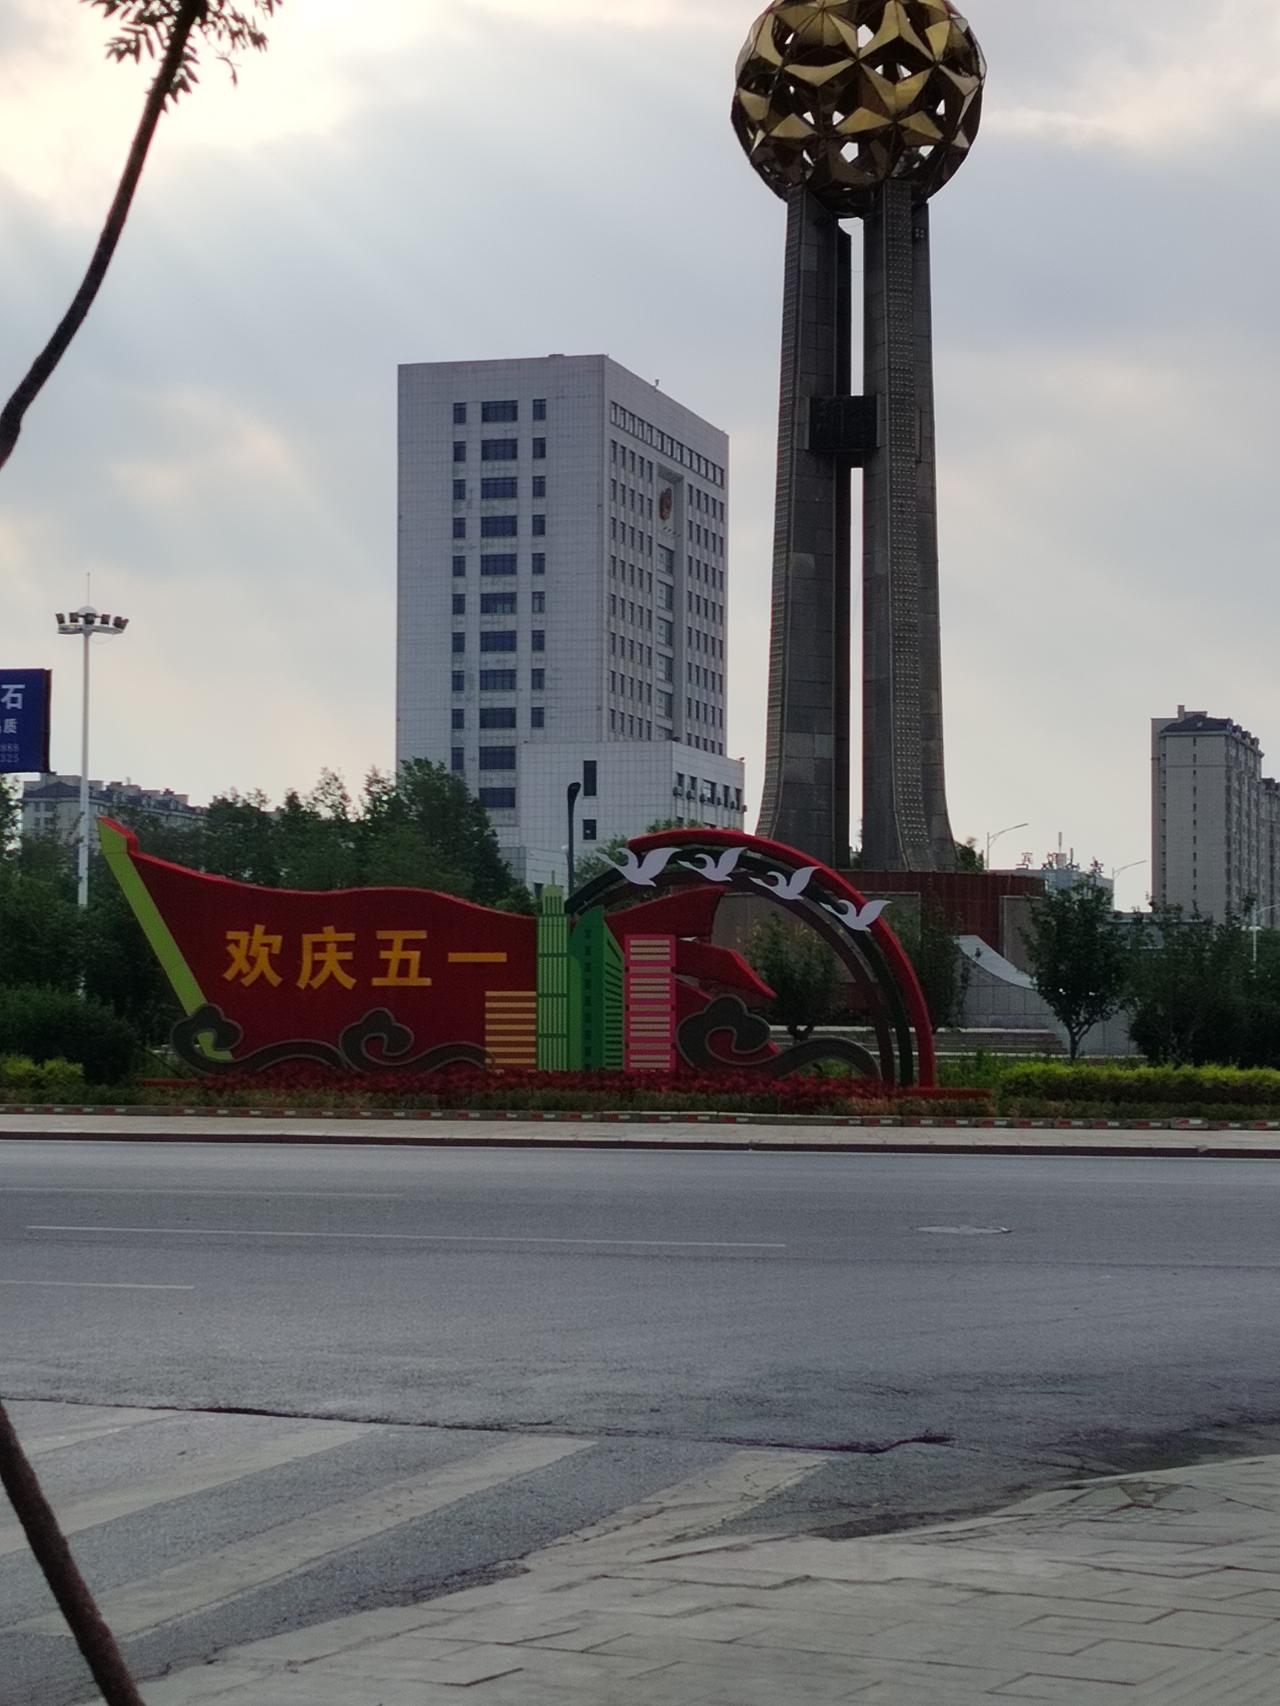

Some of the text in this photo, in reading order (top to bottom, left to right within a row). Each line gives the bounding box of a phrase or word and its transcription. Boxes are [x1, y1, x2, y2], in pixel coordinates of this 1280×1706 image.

[1, 684, 25, 709] 石
[222, 924, 508, 990] 欢庆五一
